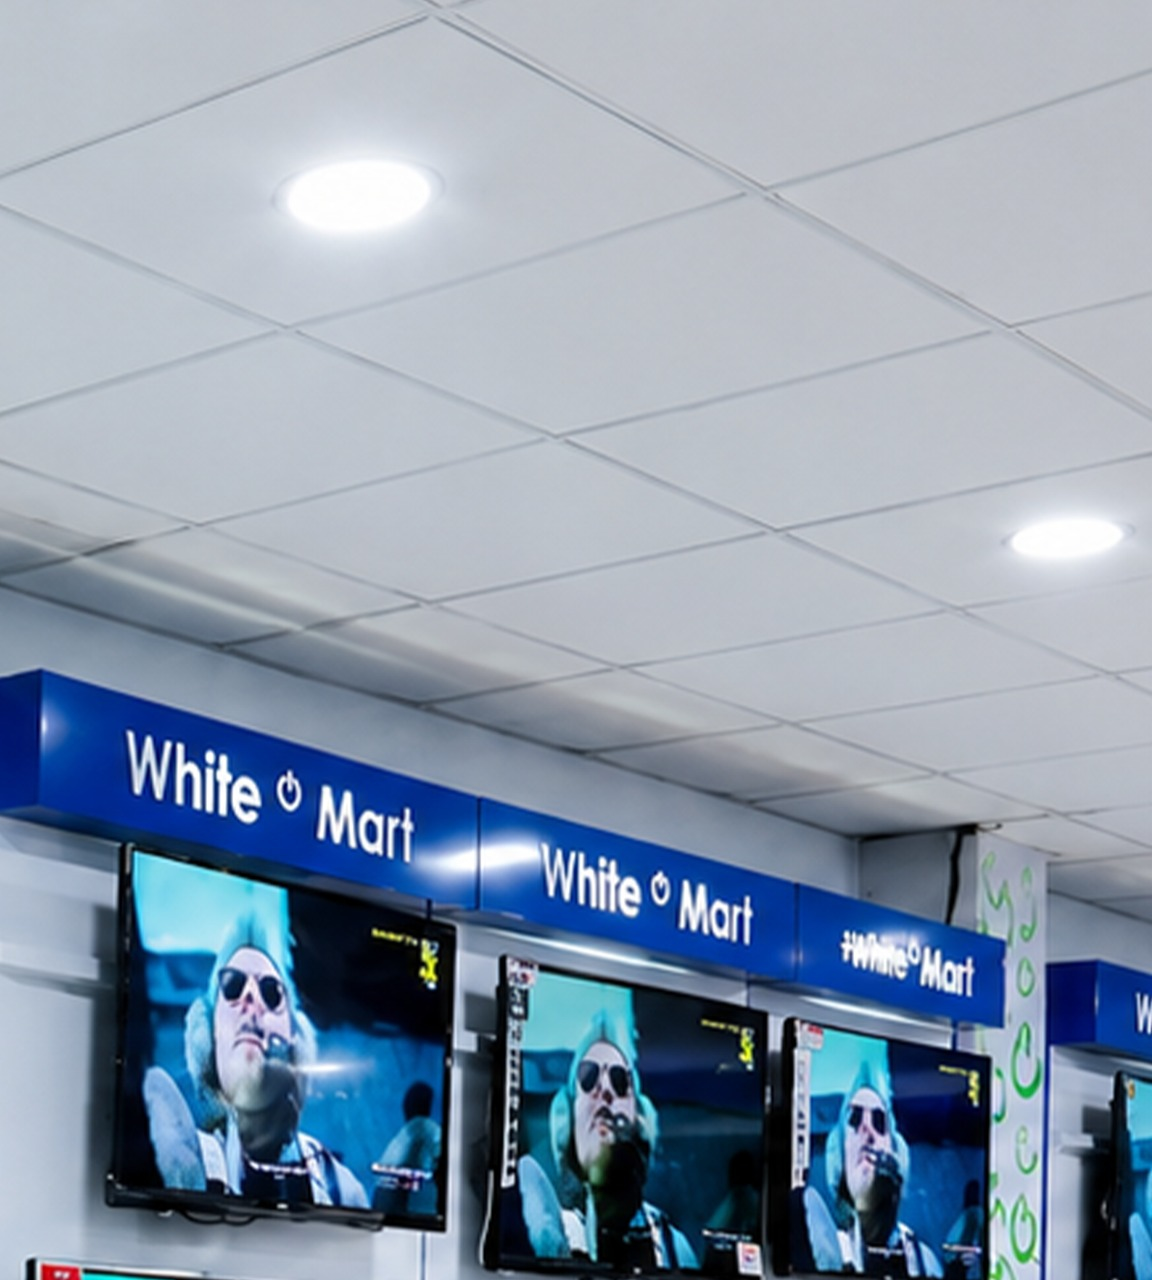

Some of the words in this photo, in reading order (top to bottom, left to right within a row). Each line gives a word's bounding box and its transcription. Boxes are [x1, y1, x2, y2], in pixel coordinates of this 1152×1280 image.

[126, 729, 261, 824] White
[317, 785, 414, 863] Mart
[541, 843, 642, 917] White
[679, 880, 753, 946] Mart
[920, 946, 974, 997] Mart
